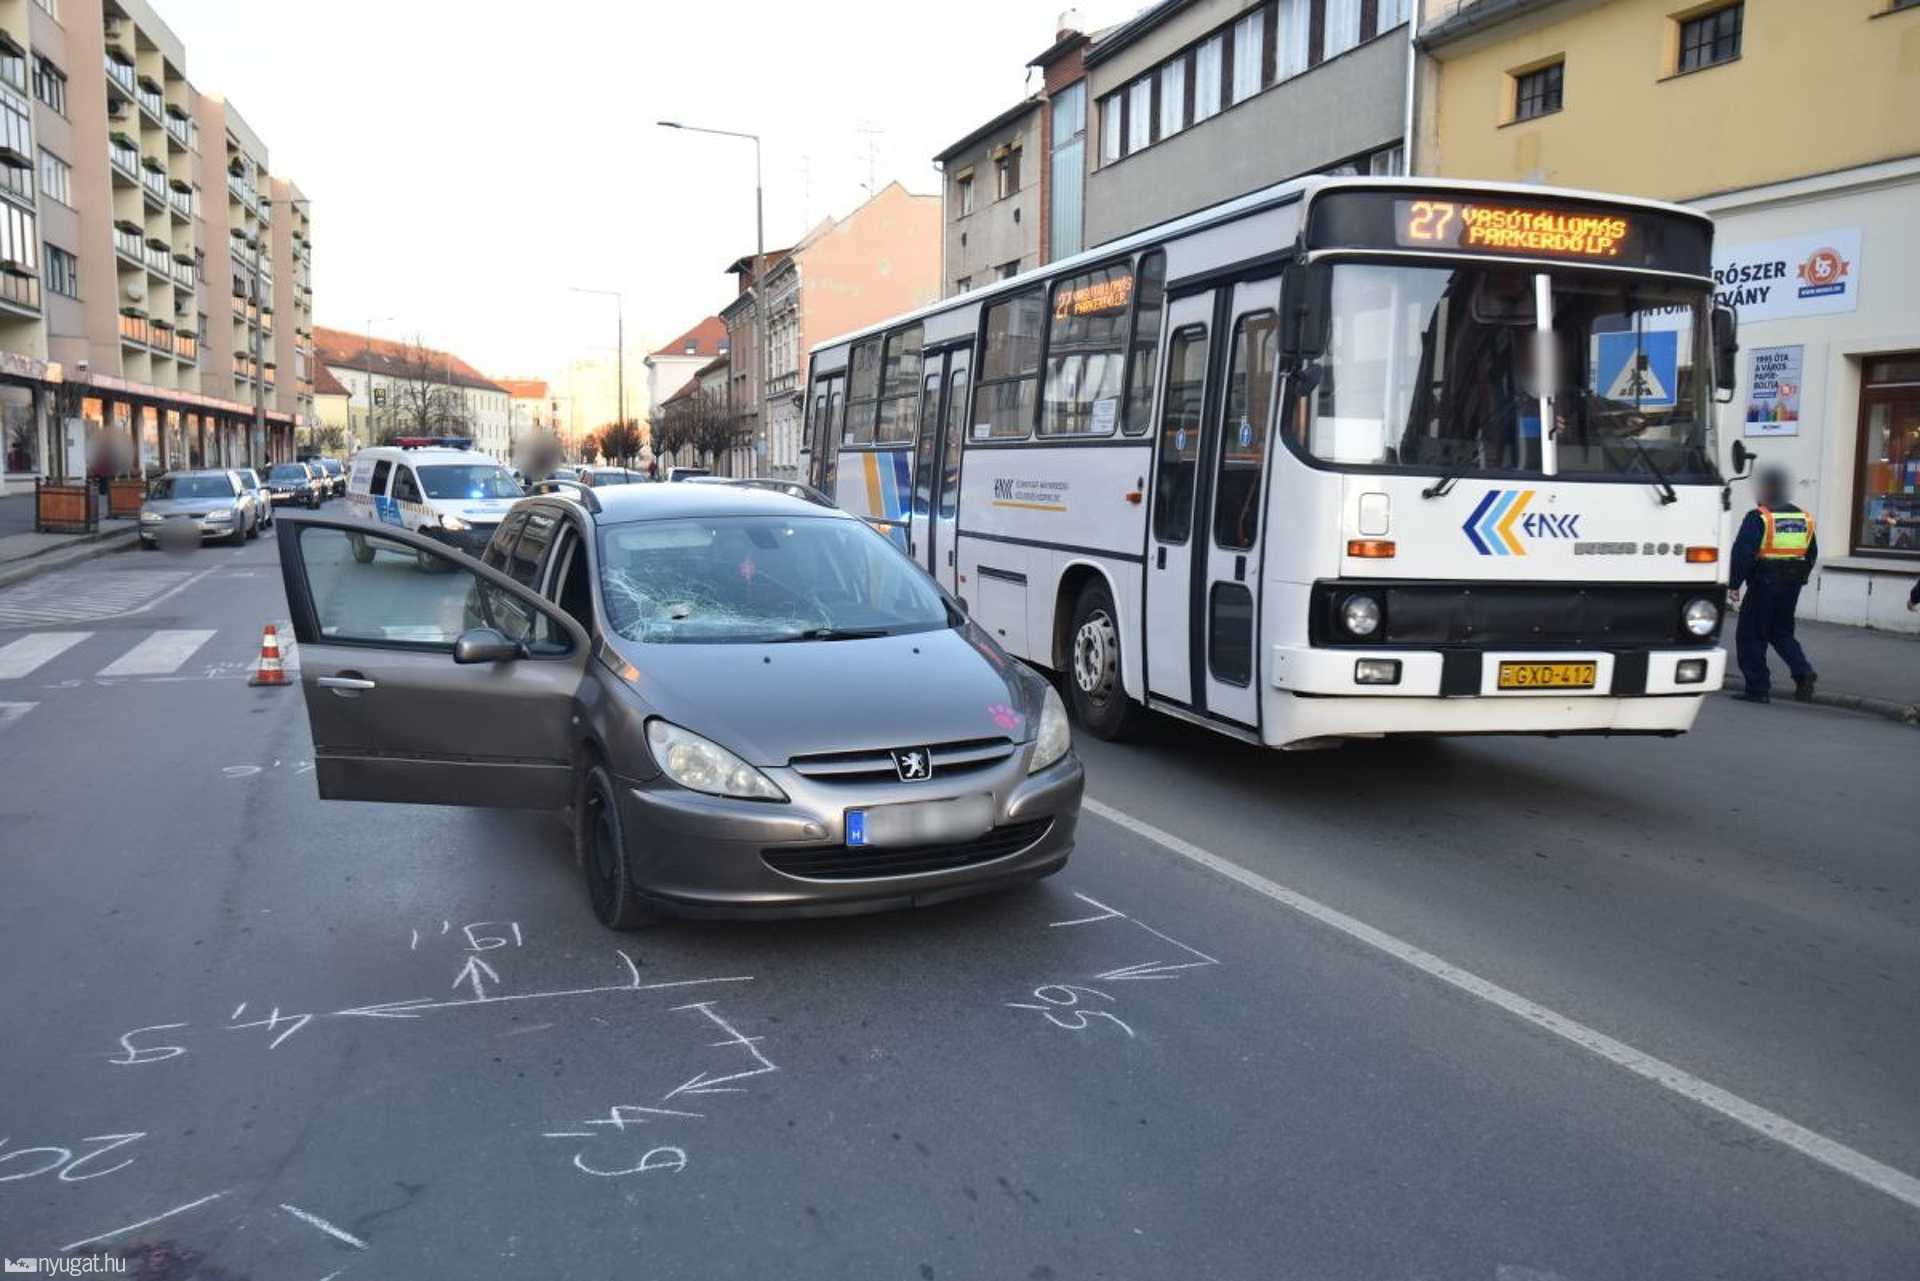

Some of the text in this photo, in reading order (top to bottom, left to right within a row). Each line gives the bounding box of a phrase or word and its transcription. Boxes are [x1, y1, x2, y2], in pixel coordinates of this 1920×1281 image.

[1409, 200, 1454, 240] 27
[1711, 261, 1786, 285] RÓSZER
[1713, 284, 1770, 306] TVÁNY
[1516, 666, 1593, 684] GXD-412
[852, 831, 861, 840] H
